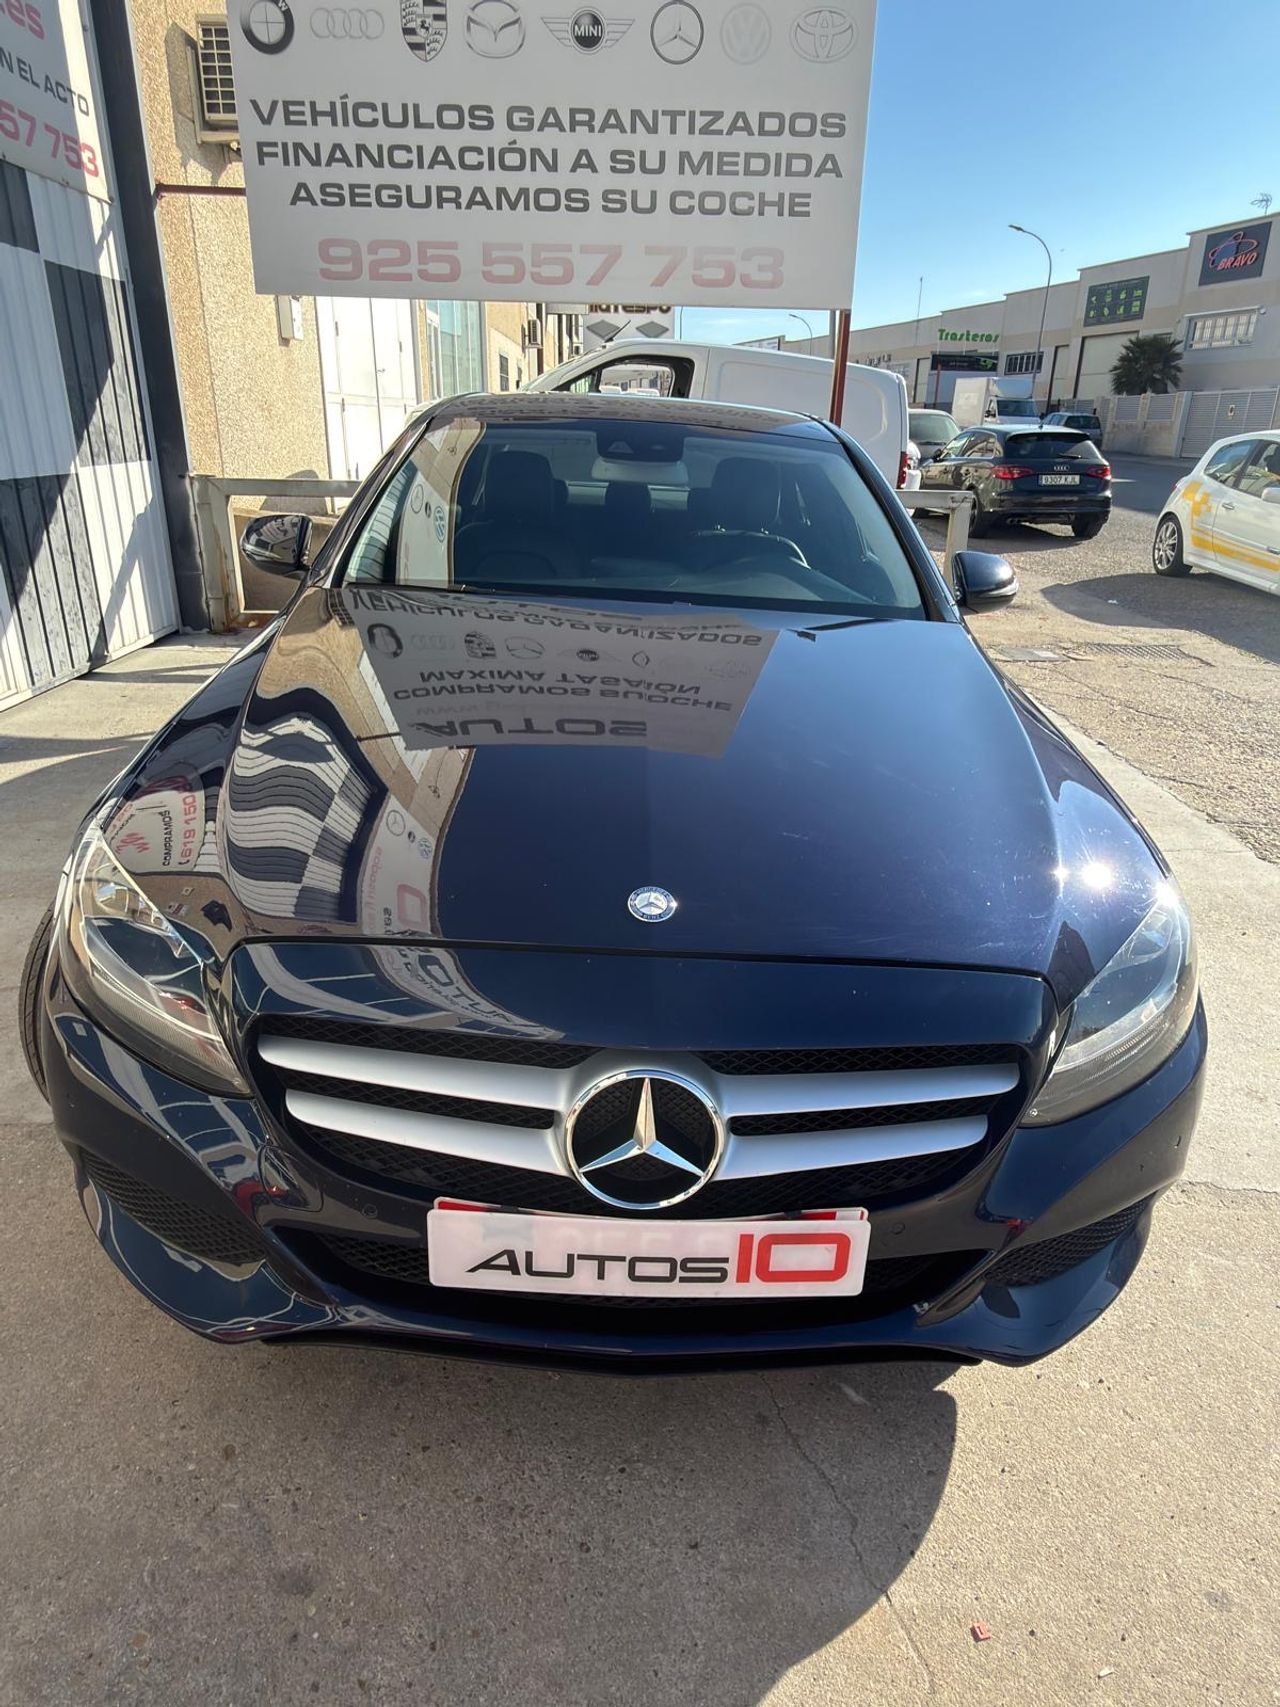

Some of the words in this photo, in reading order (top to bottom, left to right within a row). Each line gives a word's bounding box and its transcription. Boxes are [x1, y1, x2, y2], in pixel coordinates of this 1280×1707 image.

[574, 25, 602, 37] MINI
[16, 57, 41, 89] EL
[44, 74, 90, 117] ACTO
[249, 94, 495, 131] VEHÍCULOS
[505, 105, 848, 138] GARANTIZADOS
[44, 123, 100, 178] 753
[256, 139, 560, 174] FINANCIACIÓN
[570, 148, 599, 174] A
[608, 149, 666, 176] SU
[678, 150, 844, 179] MEDIDA
[289, 182, 591, 213] ASEGURAMOS
[601, 188, 658, 215] SU
[669, 190, 812, 218] COCHE
[317, 237, 462, 283] 925
[481, 242, 623, 287] 557
[645, 246, 785, 290] 753
[1217, 252, 1258, 271] BRAVO
[938, 329, 1000, 343] Trasteros
